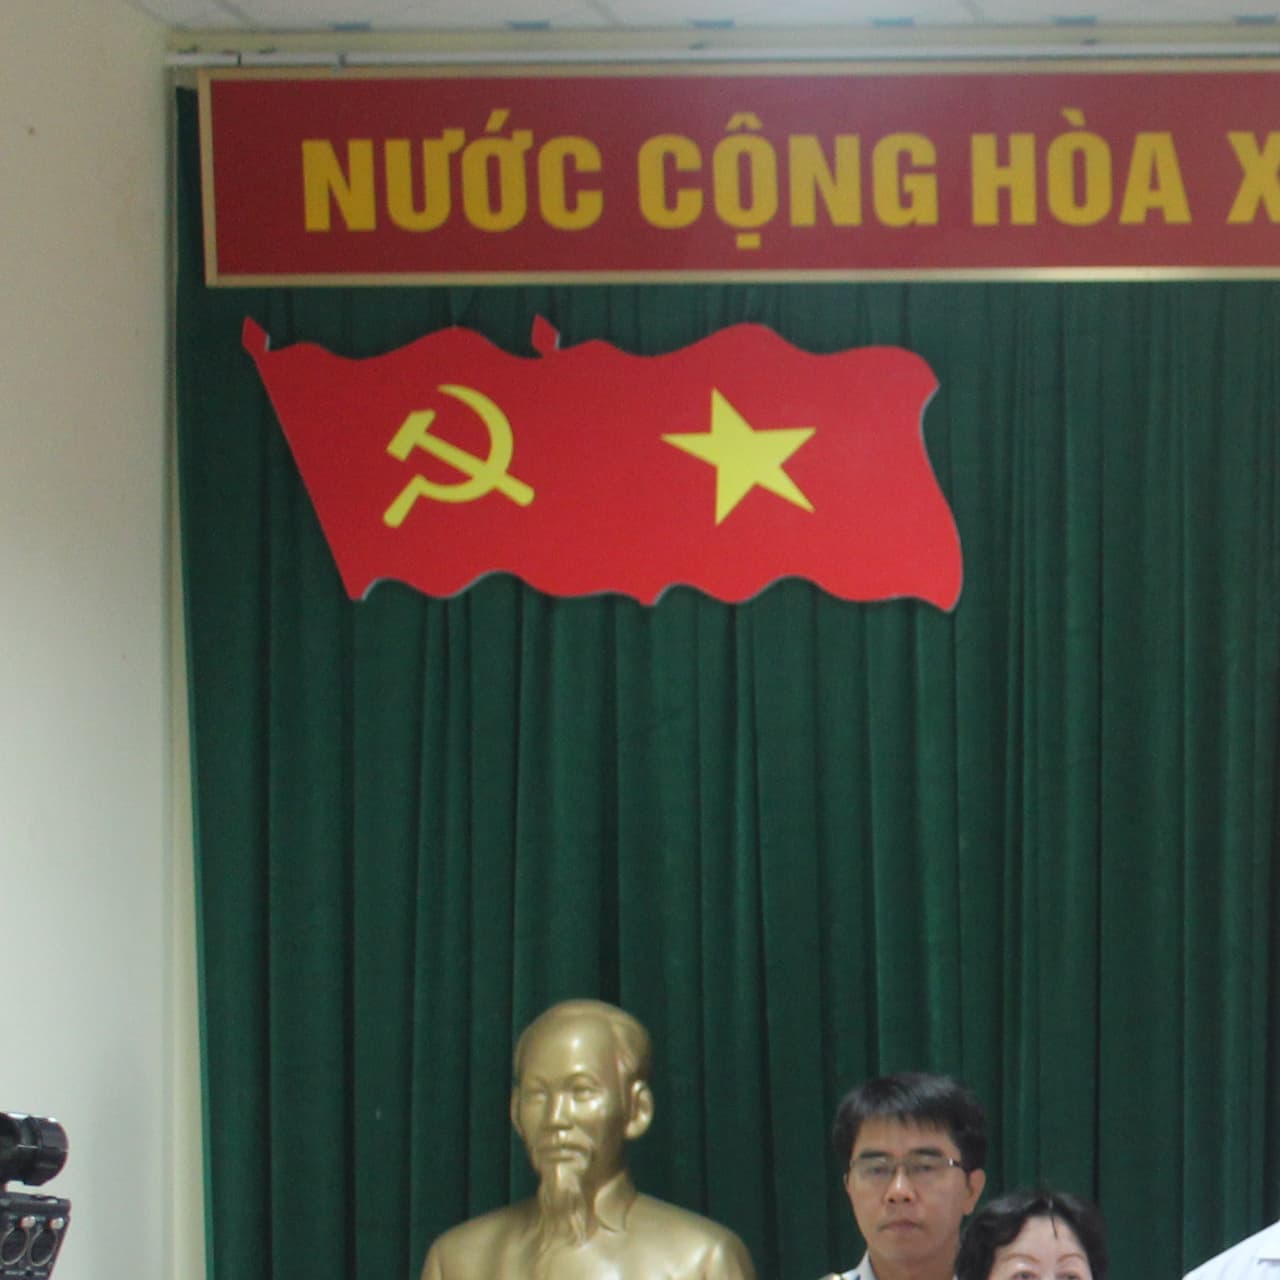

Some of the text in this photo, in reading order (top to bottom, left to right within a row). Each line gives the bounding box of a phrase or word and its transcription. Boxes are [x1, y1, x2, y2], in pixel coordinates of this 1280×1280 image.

[303, 110, 604, 232] NƯỚC
[638, 113, 938, 250] CỘNG
[972, 109, 1192, 227] HÒA
